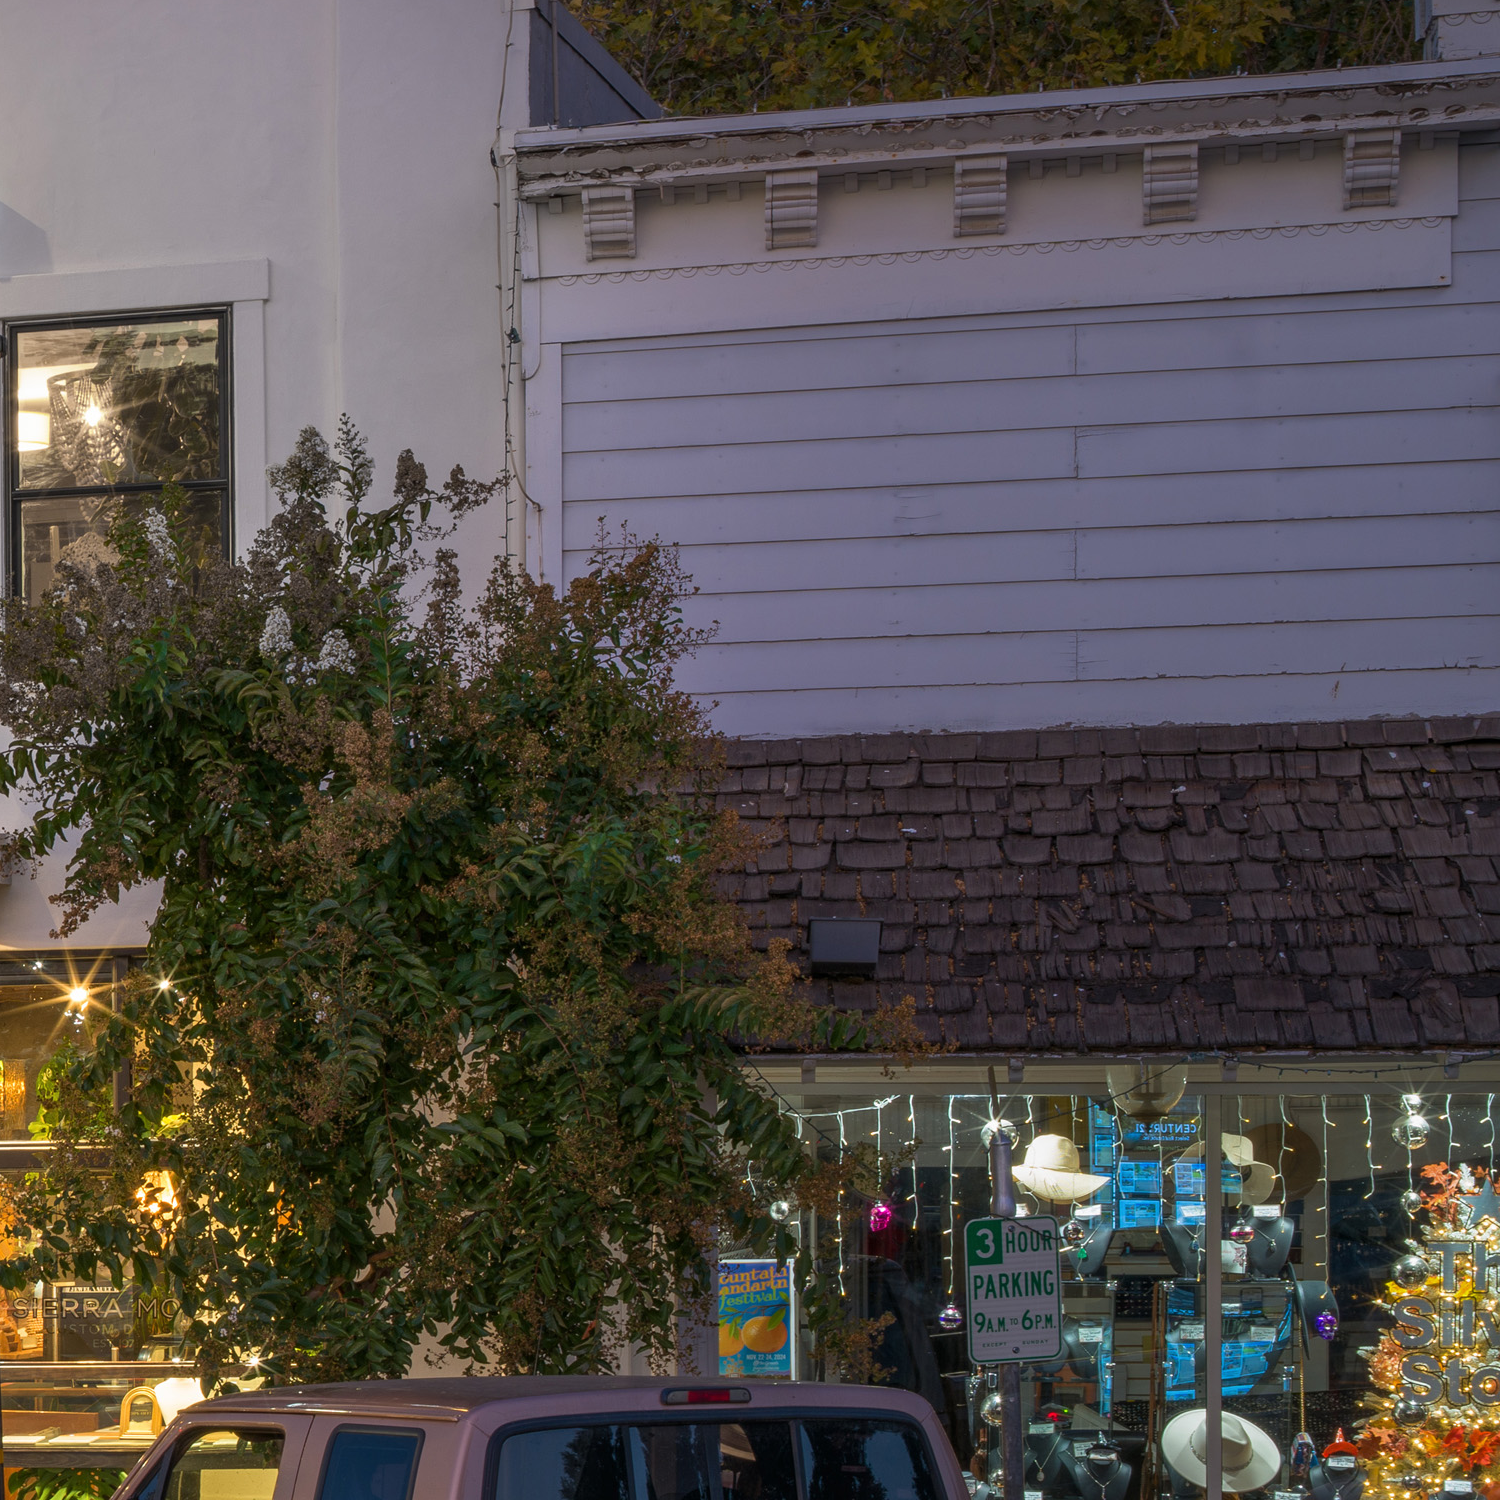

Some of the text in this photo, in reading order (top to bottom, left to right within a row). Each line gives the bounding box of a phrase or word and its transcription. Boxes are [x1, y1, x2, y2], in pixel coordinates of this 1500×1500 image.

[975, 1228, 1052, 1258] 3 HOUR
[973, 1270, 1054, 1300] PARKING
[12, 1297, 183, 1319] SIERRA MO
[719, 1288, 780, 1313] festival
[1010, 1318, 1018, 1326] TO
